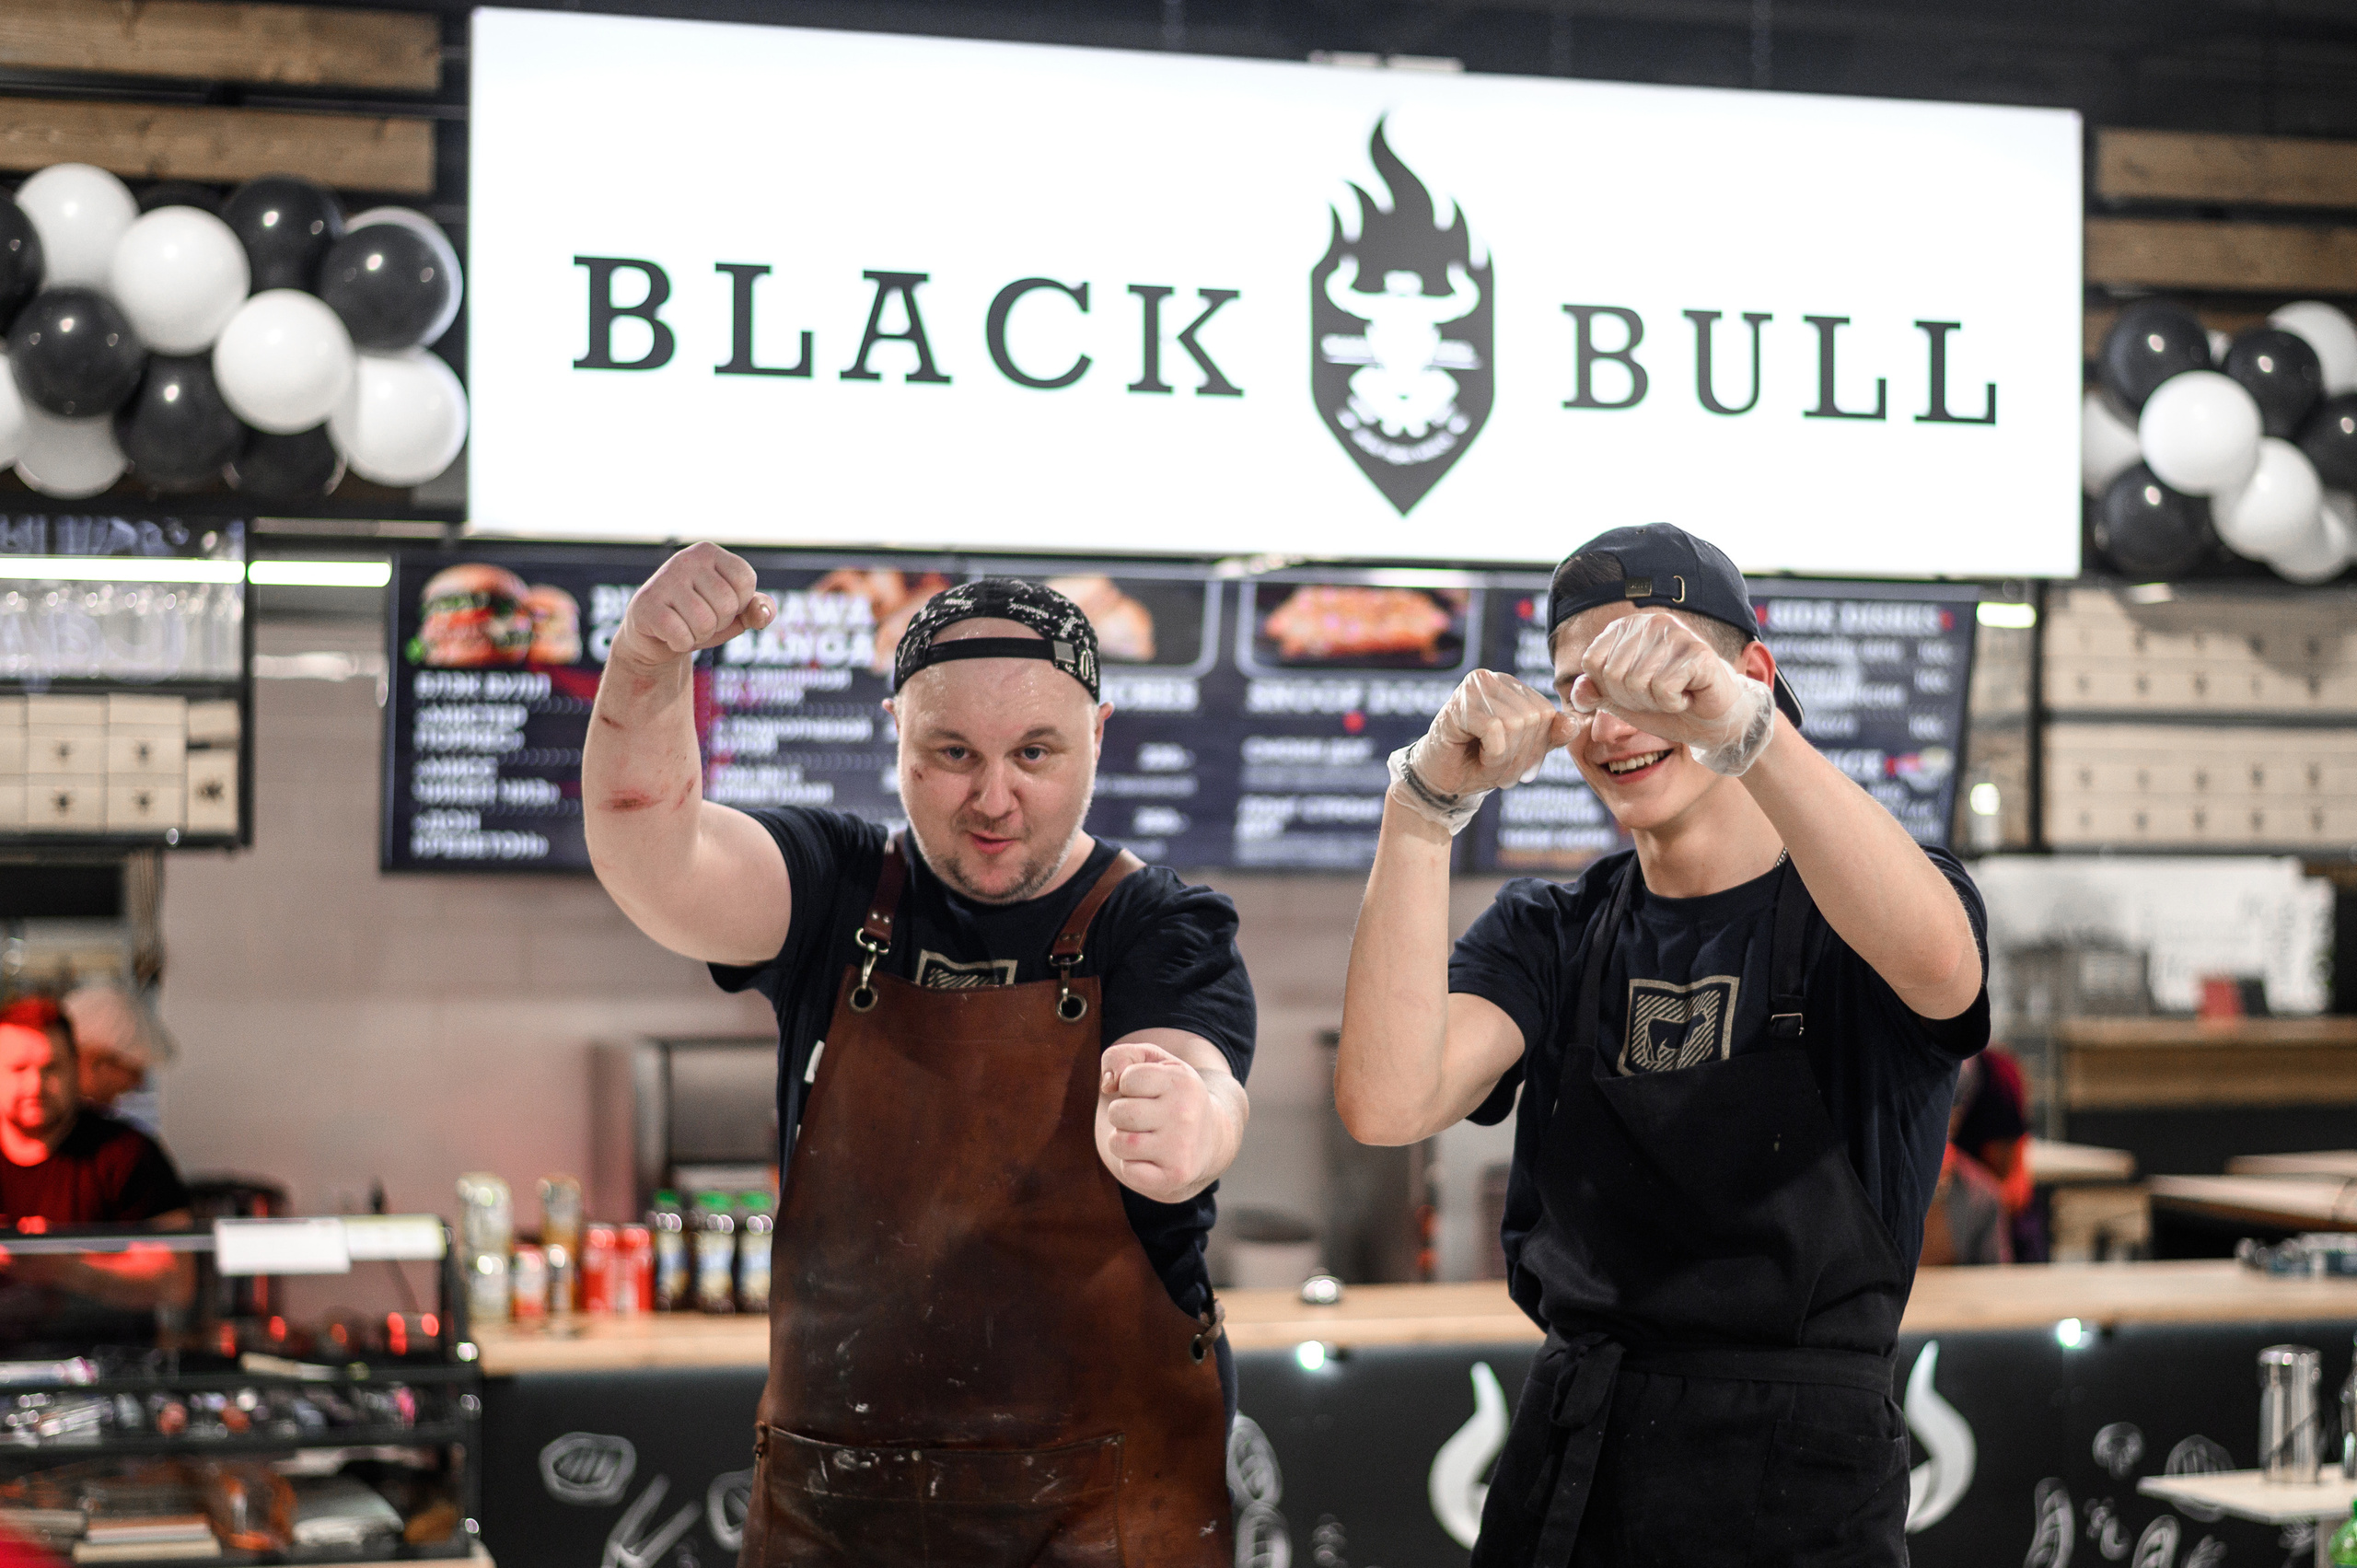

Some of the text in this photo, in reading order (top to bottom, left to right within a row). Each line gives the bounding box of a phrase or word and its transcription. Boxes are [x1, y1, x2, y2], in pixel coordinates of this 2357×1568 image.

[573, 255, 1996, 425] BLACK BULL
[1009, 602, 1049, 620] Reebok
